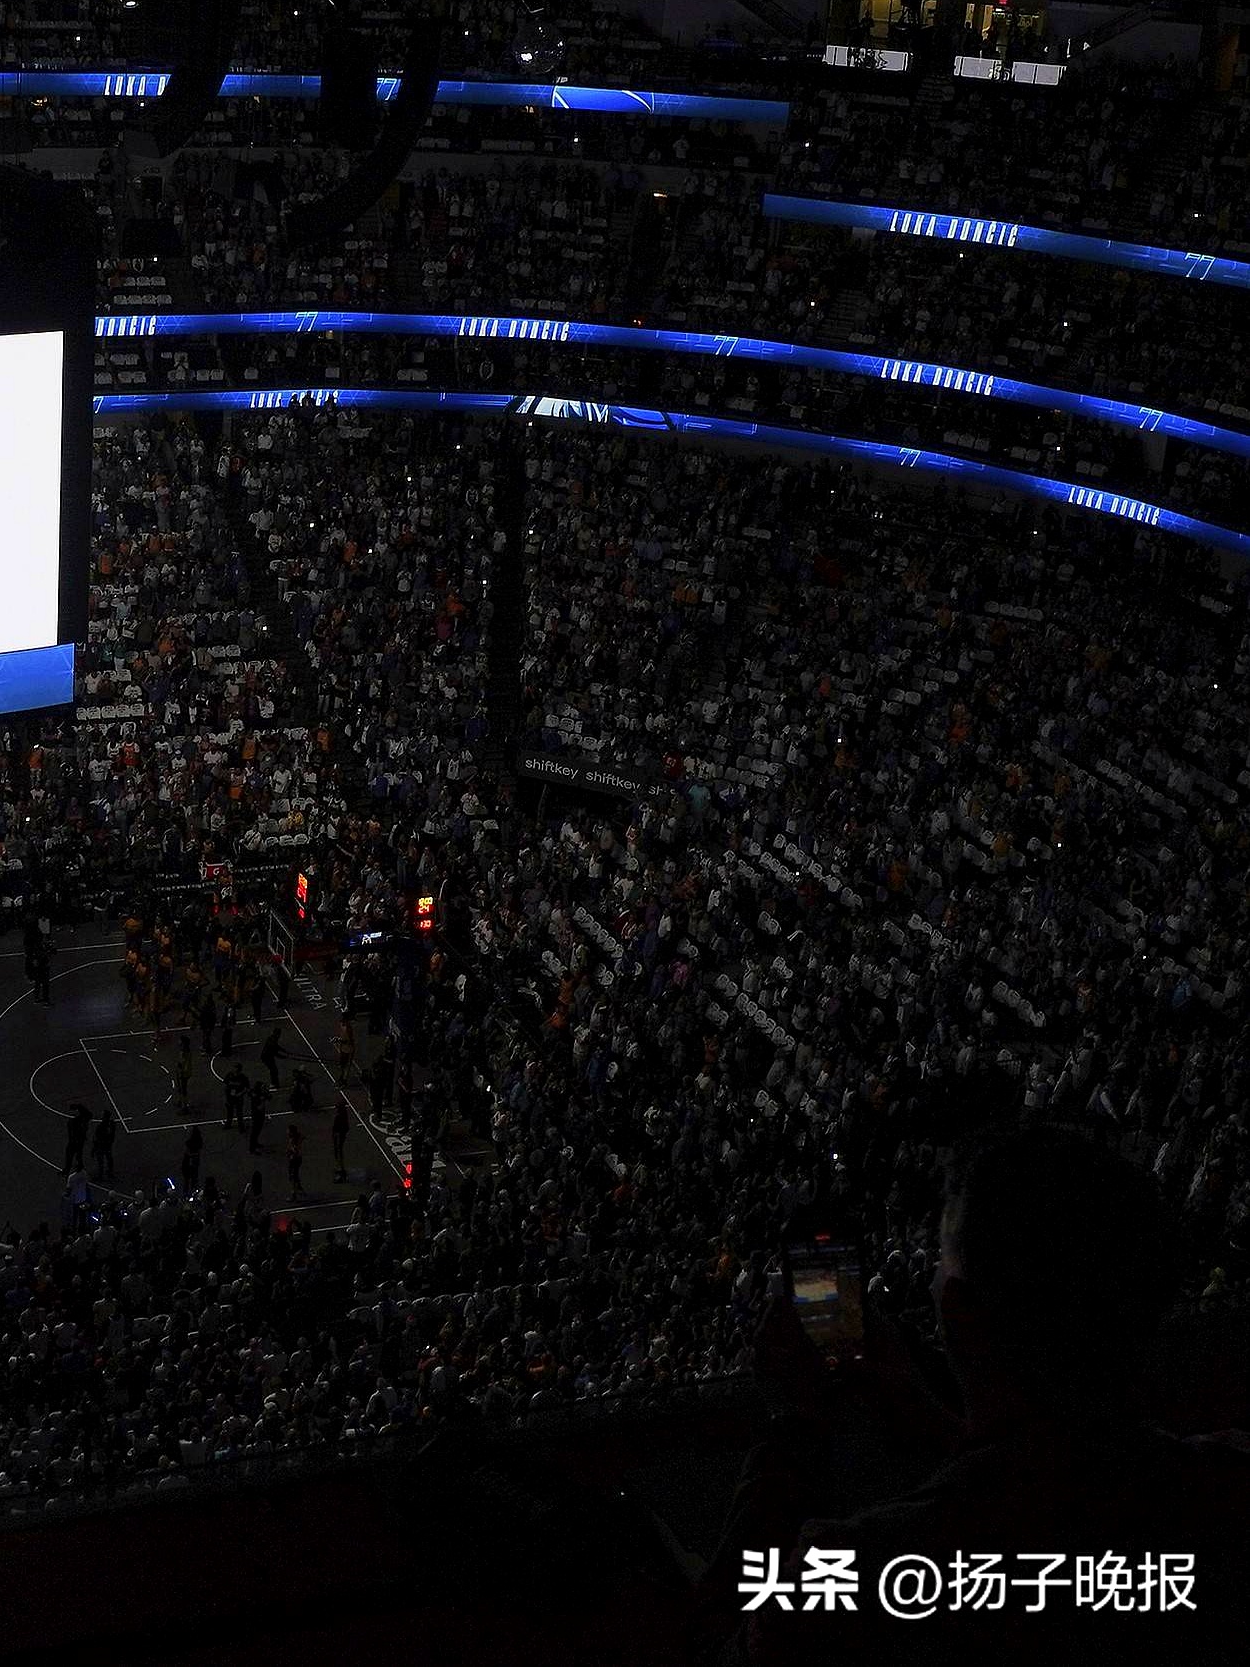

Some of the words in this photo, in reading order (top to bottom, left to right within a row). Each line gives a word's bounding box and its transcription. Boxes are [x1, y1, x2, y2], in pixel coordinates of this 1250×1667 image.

[104, 75, 146, 96] LUKA
[890, 211, 937, 237] LUKA
[1184, 252, 1216, 280] 77
[295, 311, 319, 332] 77
[459, 317, 498, 337] LUKA
[714, 335, 739, 356] 77
[880, 359, 924, 383] LUKA
[1139, 407, 1165, 432] 77
[900, 447, 921, 467] 77
[1068, 487, 1104, 510] LUKA
[525, 758, 579, 779] shiftkey
[585, 770, 642, 791] shiftkey
